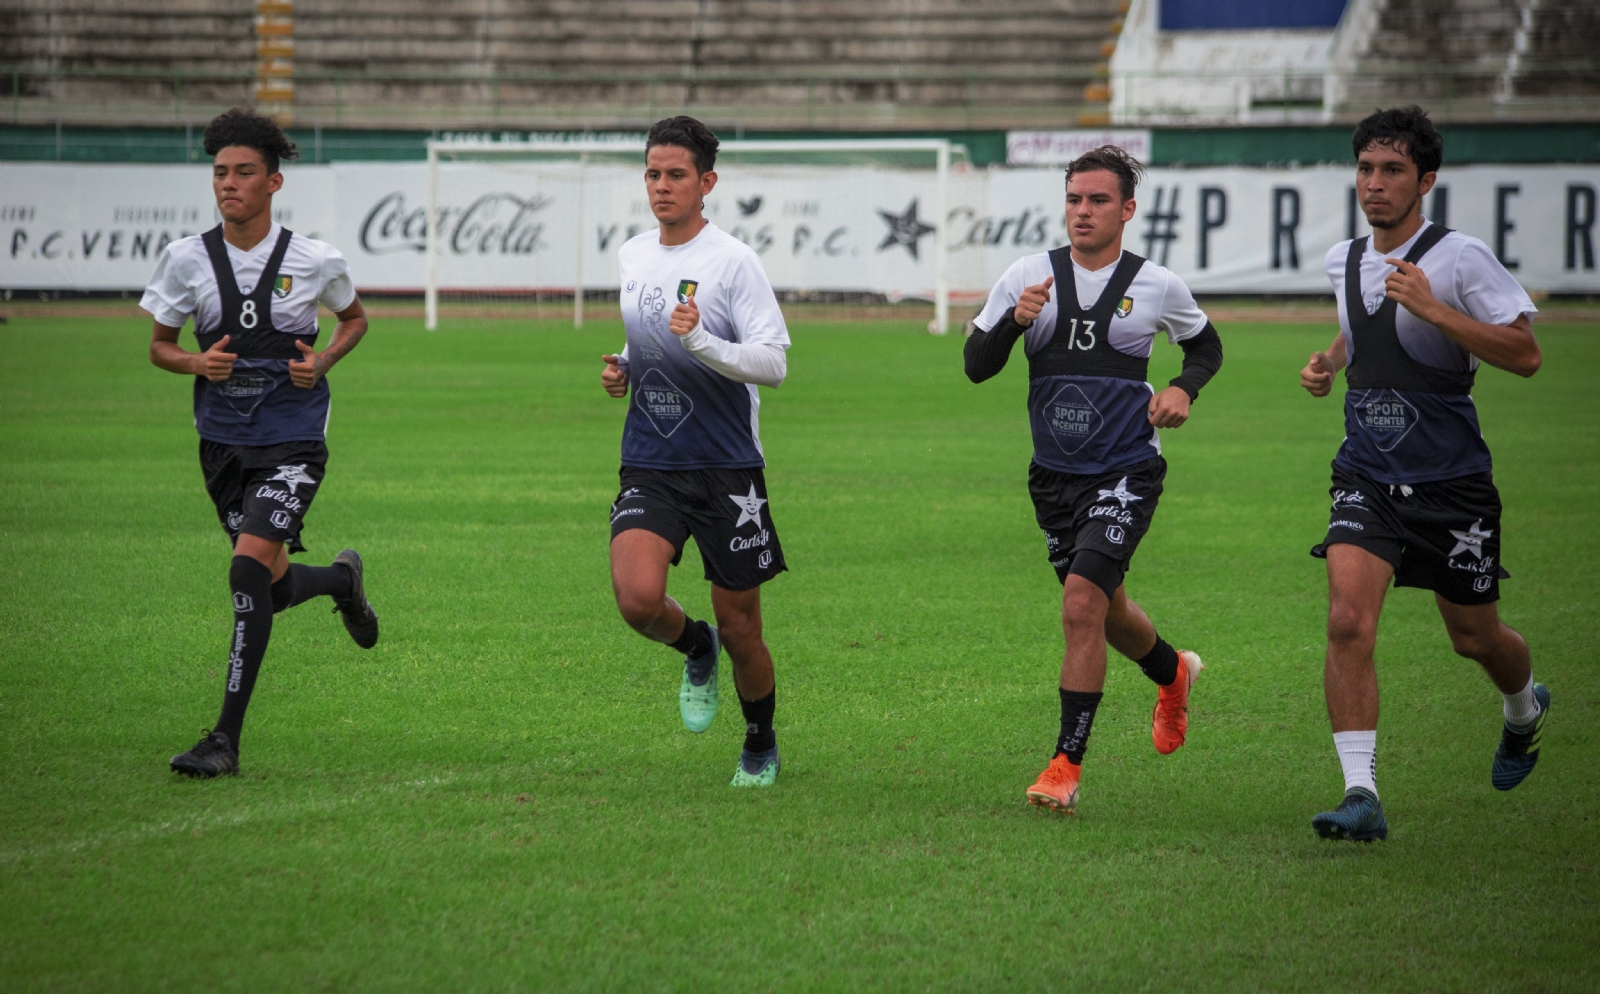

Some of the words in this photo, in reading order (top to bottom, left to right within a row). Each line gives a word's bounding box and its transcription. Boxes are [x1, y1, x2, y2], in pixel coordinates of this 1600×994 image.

[239, 300, 259, 329] 8
[1067, 318, 1097, 351] 13
[231, 386, 264, 395] CENTER
[643, 390, 681, 404] SPORT
[1055, 406, 1092, 422] SPORT
[1366, 402, 1405, 416] SPORT
[1059, 420, 1090, 432] CENTER
[1373, 416, 1406, 426] CENTER
[255, 485, 289, 503] Carl's
[729, 532, 761, 552] Carl's
